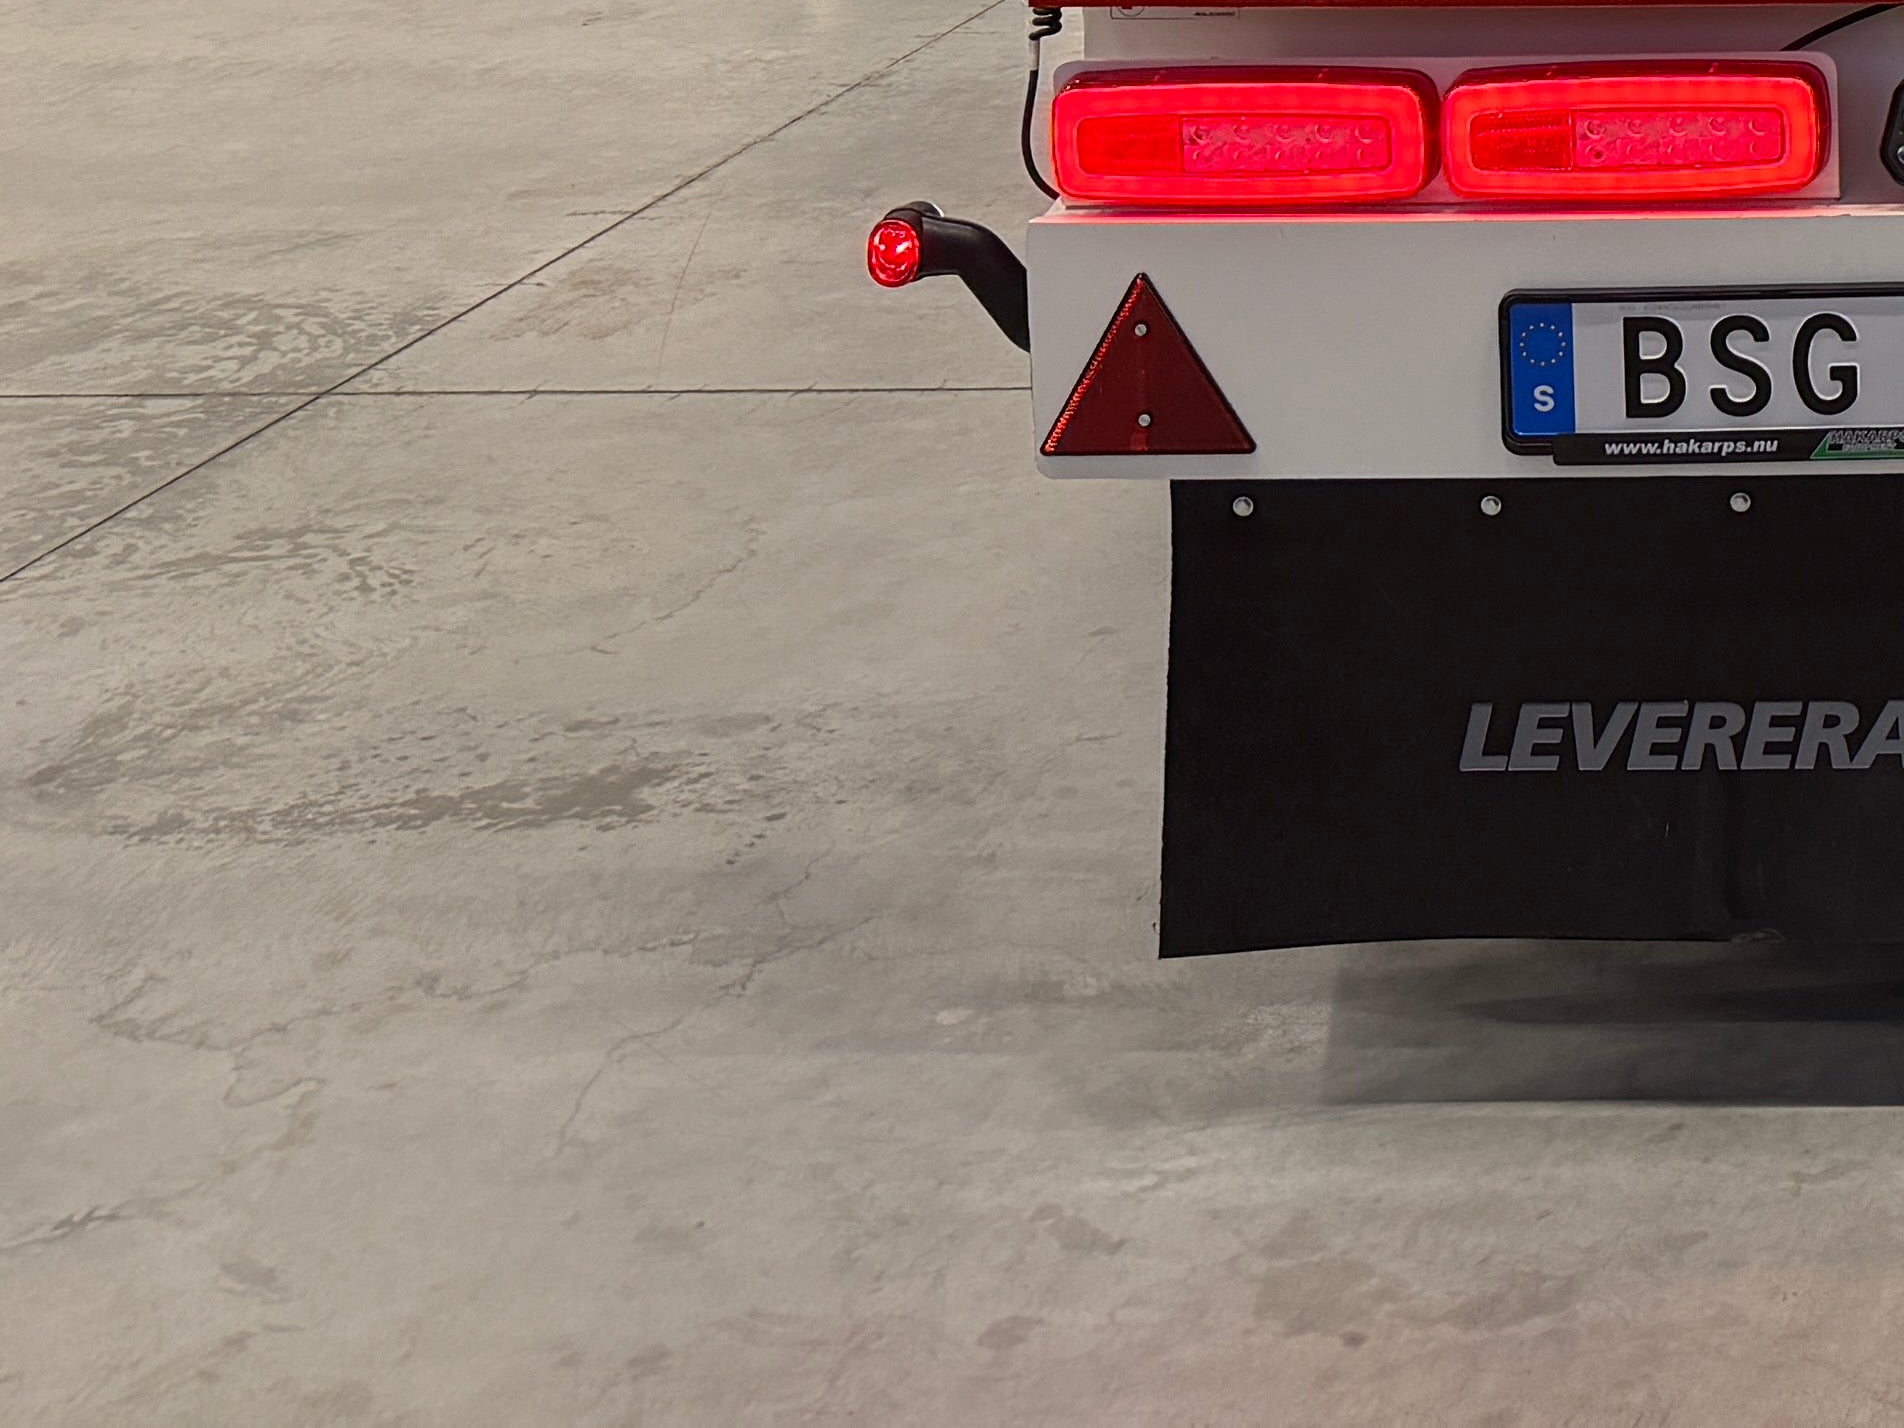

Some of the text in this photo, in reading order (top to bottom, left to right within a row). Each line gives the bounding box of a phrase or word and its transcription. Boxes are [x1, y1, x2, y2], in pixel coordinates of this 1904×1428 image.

[1623, 310, 1861, 419] BSG
[1533, 384, 1556, 413] S
[1604, 437, 1778, 457] www.hakarps.nu
